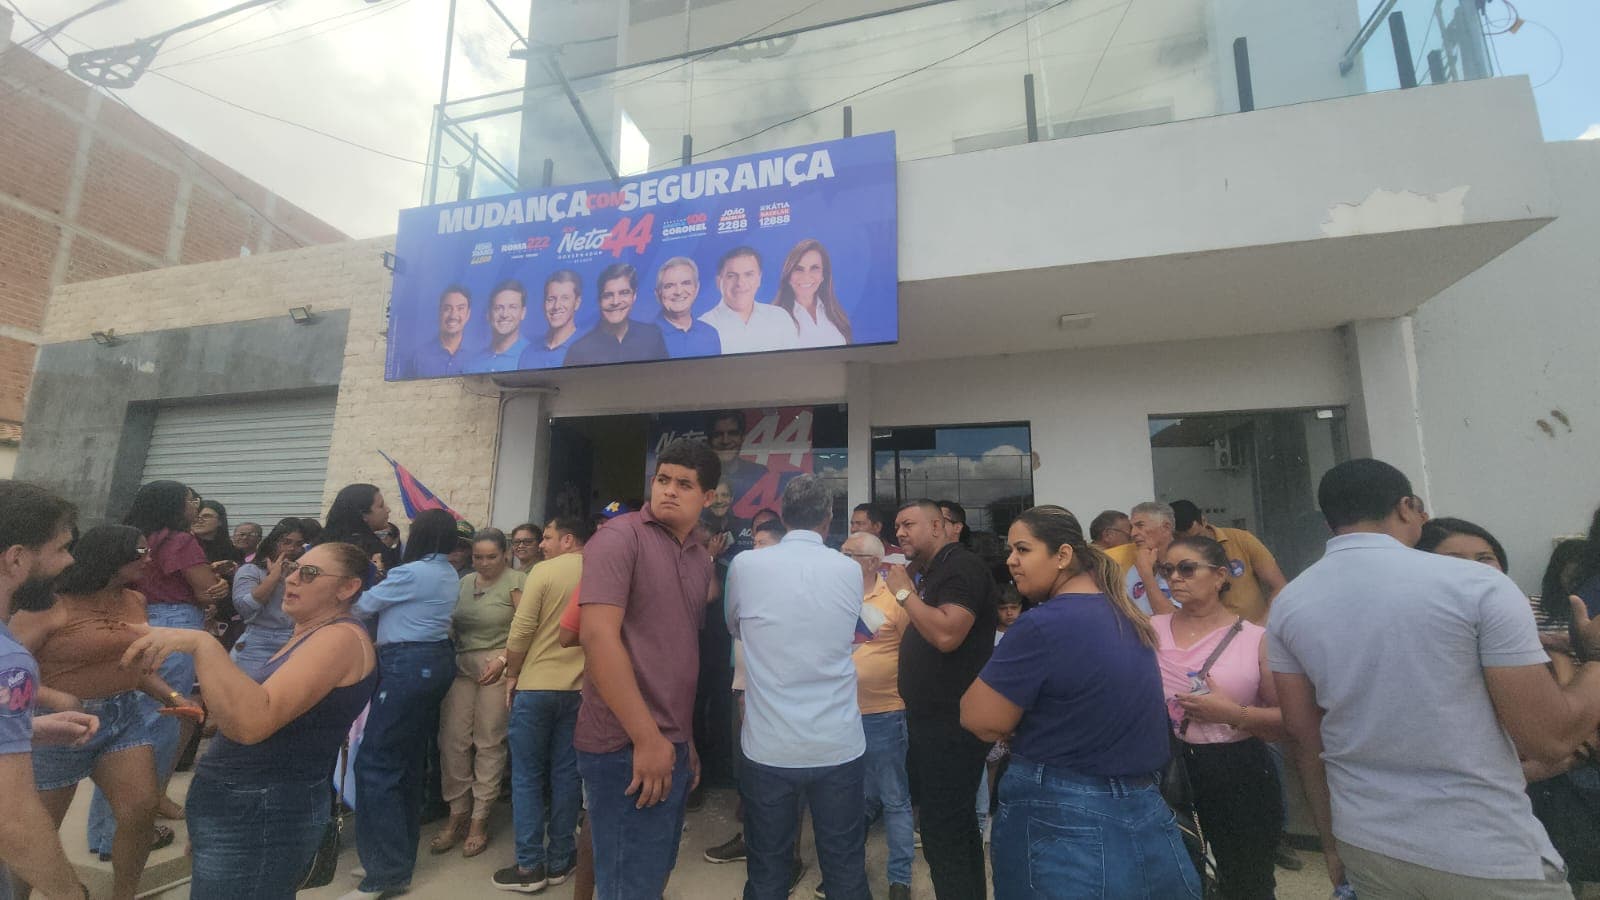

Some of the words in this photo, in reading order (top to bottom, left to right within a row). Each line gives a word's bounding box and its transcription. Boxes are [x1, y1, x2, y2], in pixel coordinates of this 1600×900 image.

[438, 190, 590, 234] MUDANÇA
[586, 192, 626, 209] COM
[618, 150, 835, 212] SEGURANÇA
[662, 223, 707, 236] CORONEL
[718, 219, 748, 231] 2288
[760, 215, 790, 226] 12888
[557, 228, 612, 253] Neto
[600, 213, 654, 258] 44
[740, 410, 813, 467] 44
